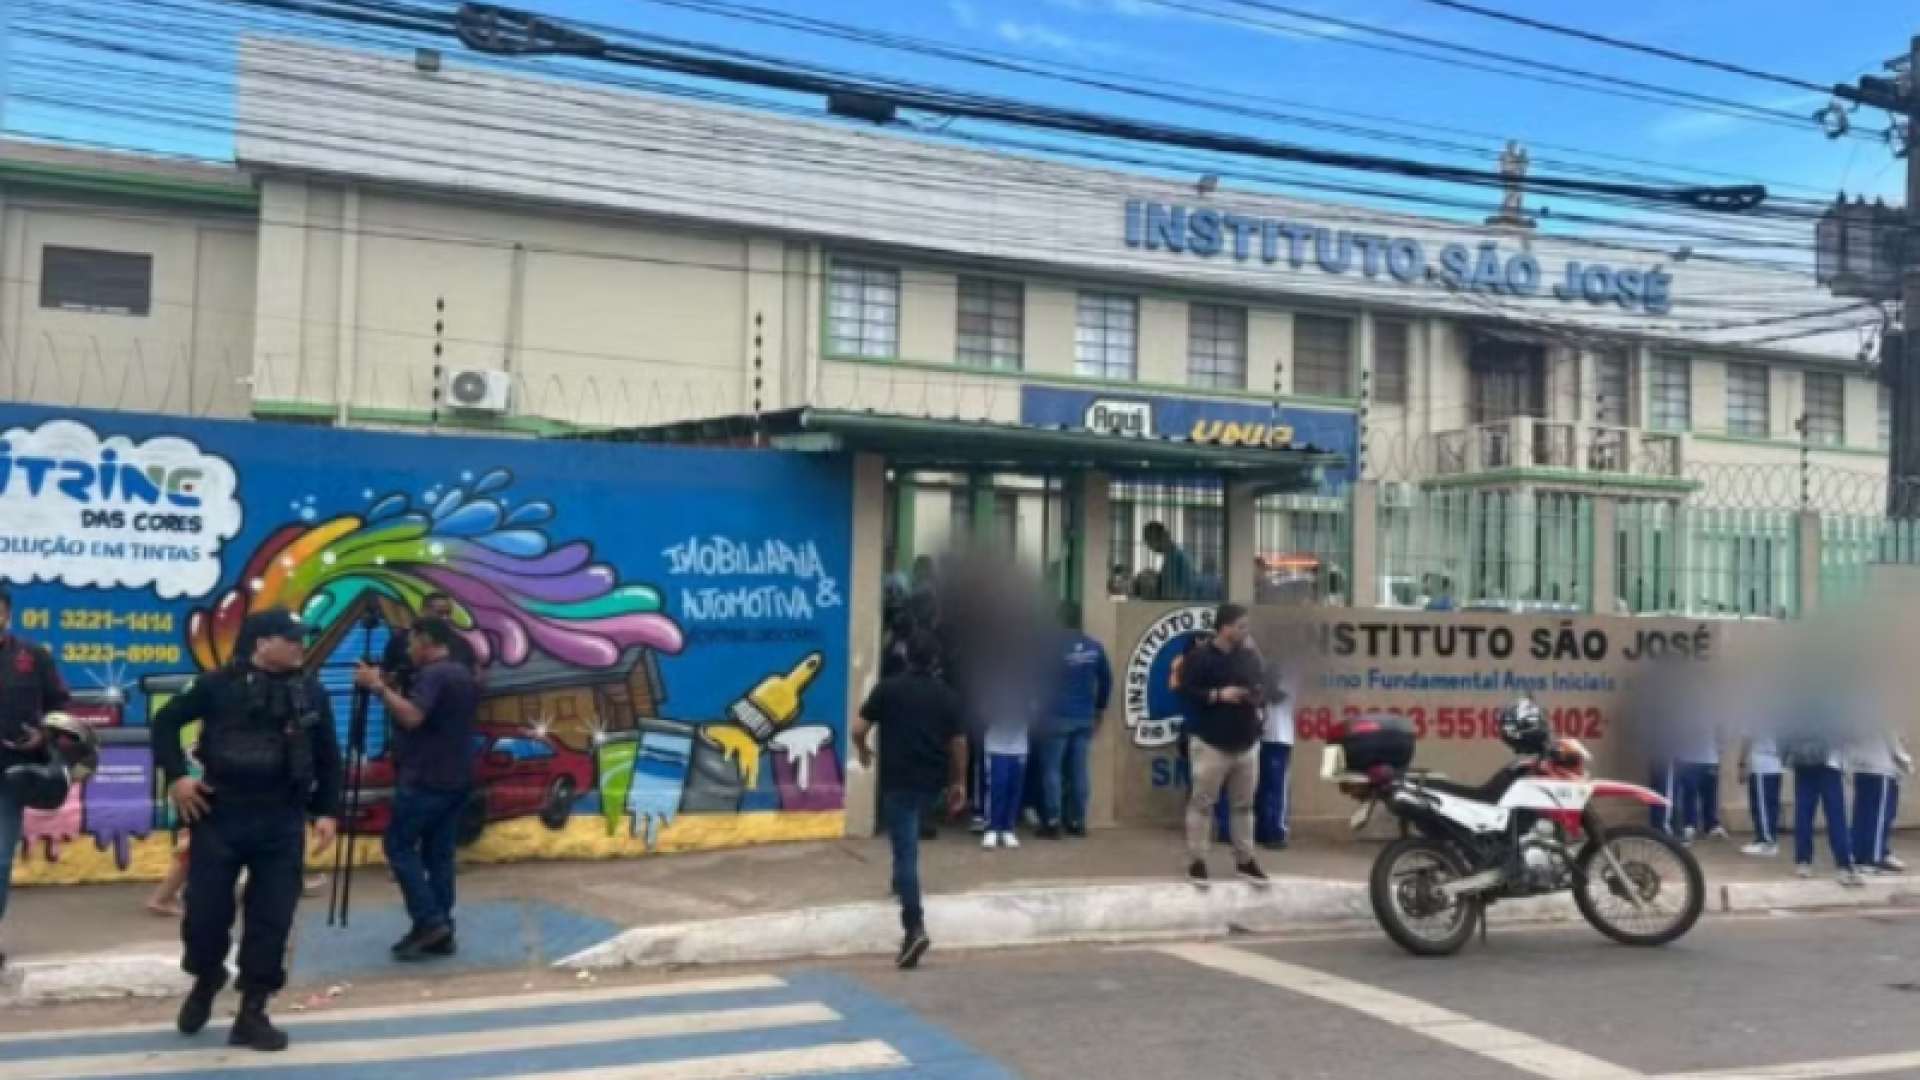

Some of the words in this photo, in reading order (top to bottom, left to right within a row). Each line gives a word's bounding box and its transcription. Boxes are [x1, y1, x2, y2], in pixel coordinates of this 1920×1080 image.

[1125, 201, 1425, 281] INSTITUTO
[1439, 242, 1541, 295] SÃO
[1553, 263, 1673, 314] JOSÉ
[81, 509, 126, 529] DAS
[133, 512, 203, 532] CORES
[0, 535, 83, 559] OLUÇÃO
[91, 543, 125, 559] EM
[131, 543, 201, 562] TINTAS
[1531, 619, 1608, 661] SÃO
[1622, 624, 1711, 661] JOSÉ
[1368, 667, 1498, 690] Fundamental
